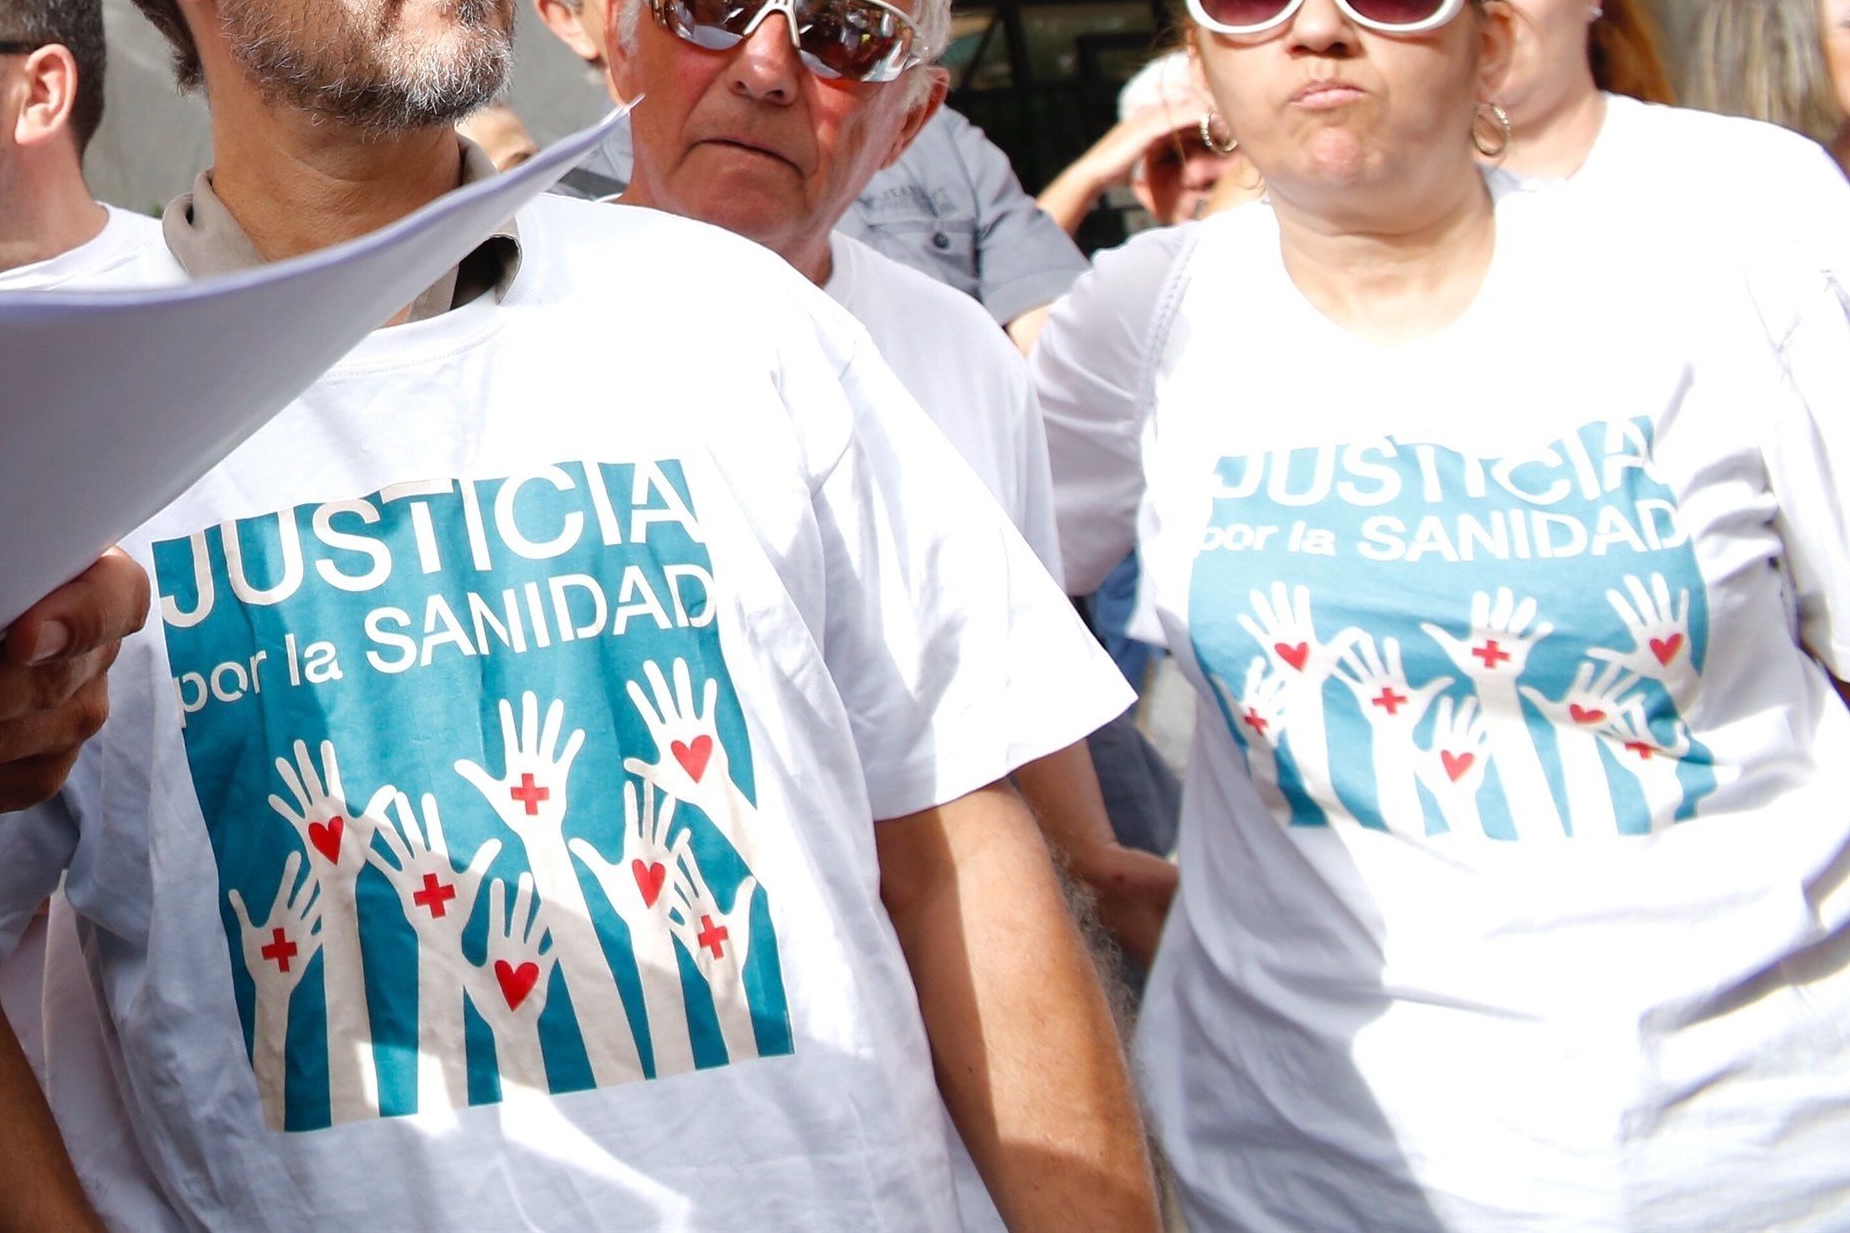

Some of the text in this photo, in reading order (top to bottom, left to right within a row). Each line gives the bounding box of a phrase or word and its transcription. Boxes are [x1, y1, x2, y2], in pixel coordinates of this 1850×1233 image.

[160, 458, 706, 629] JUSTICIA
[1194, 498, 1692, 563] por la SANIDAD
[171, 563, 717, 729] por la SANIDAD
